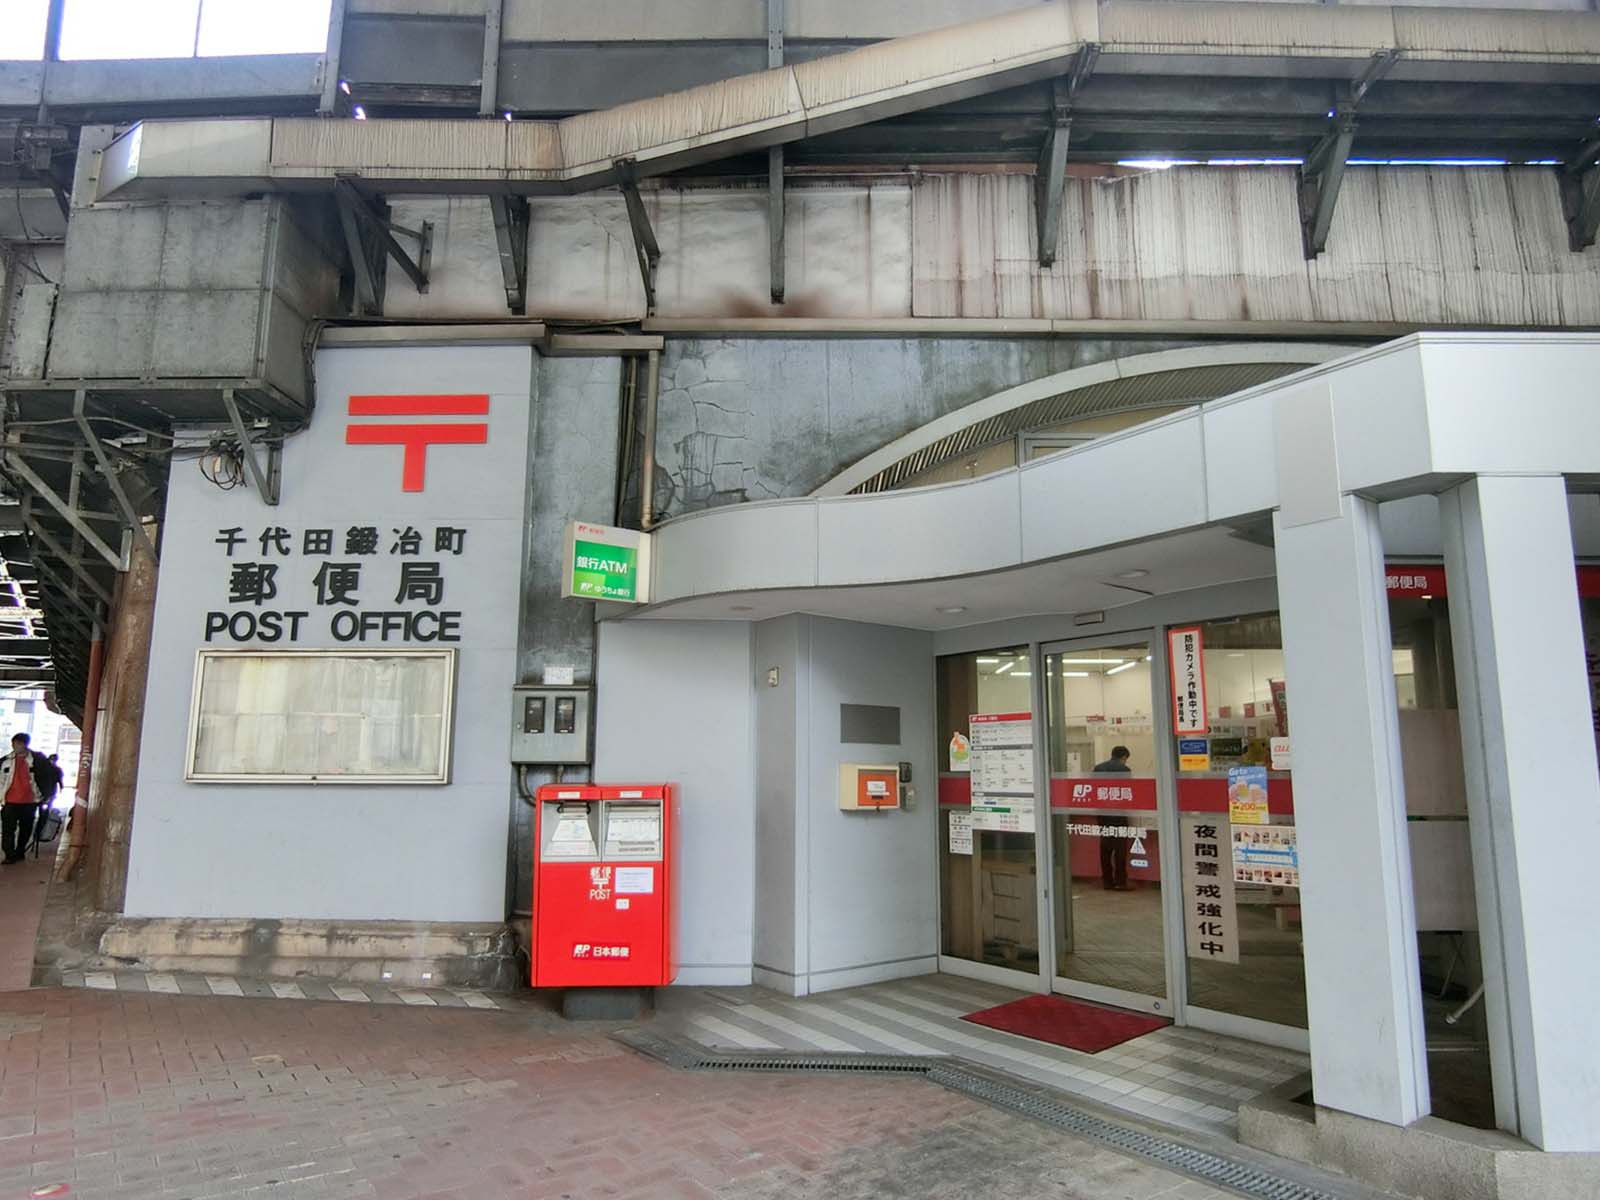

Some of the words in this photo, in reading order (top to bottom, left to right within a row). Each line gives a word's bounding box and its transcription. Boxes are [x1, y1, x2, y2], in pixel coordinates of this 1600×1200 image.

[215, 526, 467, 556] 千代田鍛冶町
[576, 555, 628, 574] 銀行ATM
[228, 561, 444, 606] 郵便局
[1385, 575, 1428, 590] 郵便局
[204, 610, 309, 643] POST
[330, 610, 462, 642] OFFICE
[1184, 633, 1198, 728] 防犯カメラ作動中です
[1096, 786, 1133, 801] 郵便局
[589, 889, 611, 900] POST
[1193, 824, 1224, 956] 夜間警戒強化中
